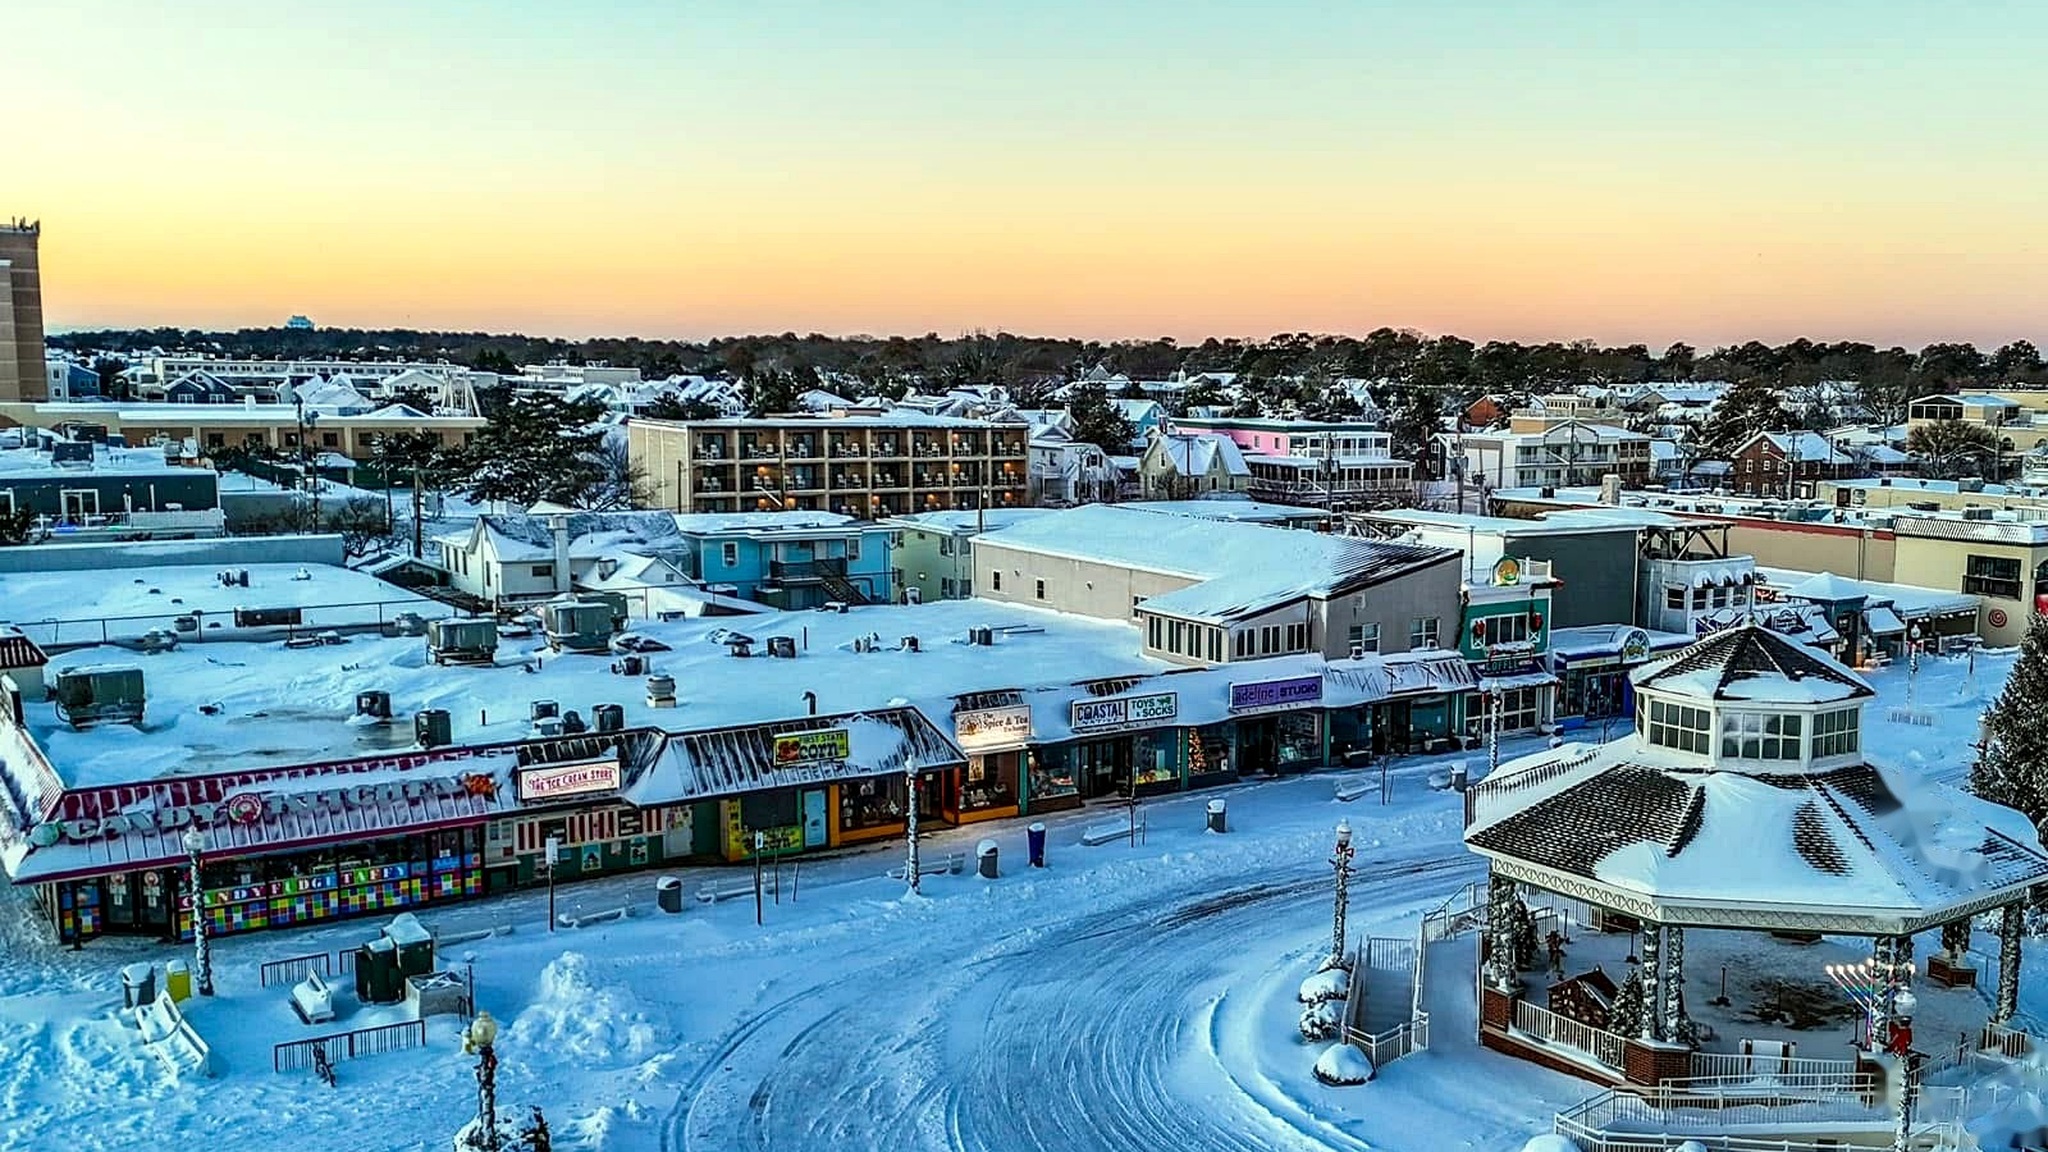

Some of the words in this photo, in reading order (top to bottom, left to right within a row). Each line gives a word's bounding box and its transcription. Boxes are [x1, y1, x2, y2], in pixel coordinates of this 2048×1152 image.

[1280, 683, 1318, 697] STUDIO
[1131, 698, 1154, 709] TOYS
[1077, 702, 1123, 721] COASTAL
[1142, 705, 1173, 718] SOCKS
[983, 717, 1004, 730] Spice
[1014, 715, 1028, 725] Tea
[821, 732, 845, 742] STATE
[799, 742, 838, 760] corn
[563, 772, 588, 784] CREAM
[591, 768, 613, 779] STORE
[64, 801, 227, 840] CANDY
